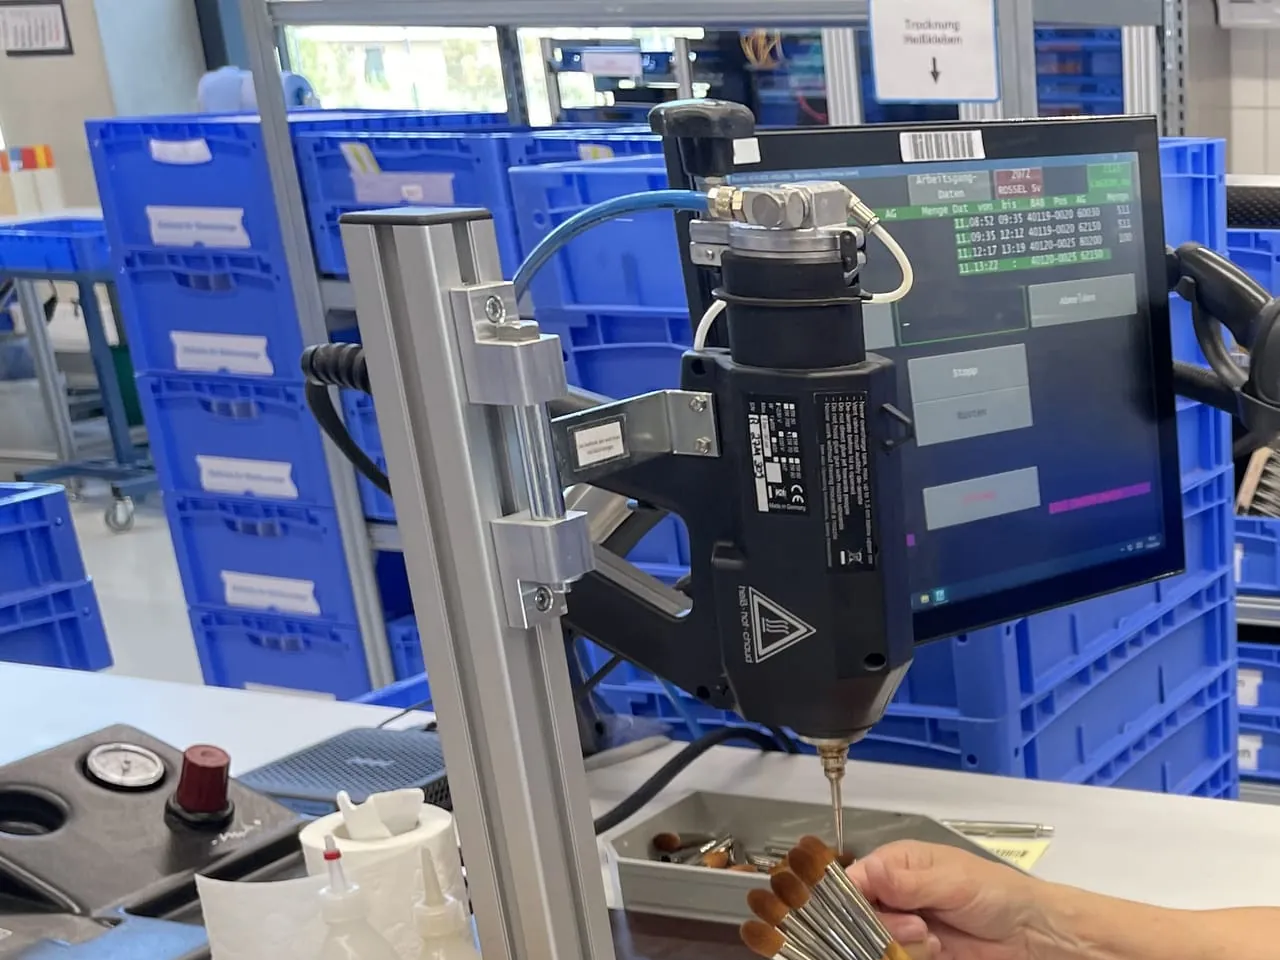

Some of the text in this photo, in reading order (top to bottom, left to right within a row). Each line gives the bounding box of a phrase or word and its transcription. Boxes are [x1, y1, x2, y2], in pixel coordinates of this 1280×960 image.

[905, 19, 960, 32] Trocknung
[916, 173, 976, 185] Arbeitsgang-
[938, 190, 965, 200] Daten
[921, 206, 948, 217] Menge
[1001, 199, 1017, 209] bis
[998, 213, 1023, 224] 09:35
[1002, 242, 1026, 254] 13:19
[741, 611, 750, 627] hot
[743, 631, 753, 663] chaud
